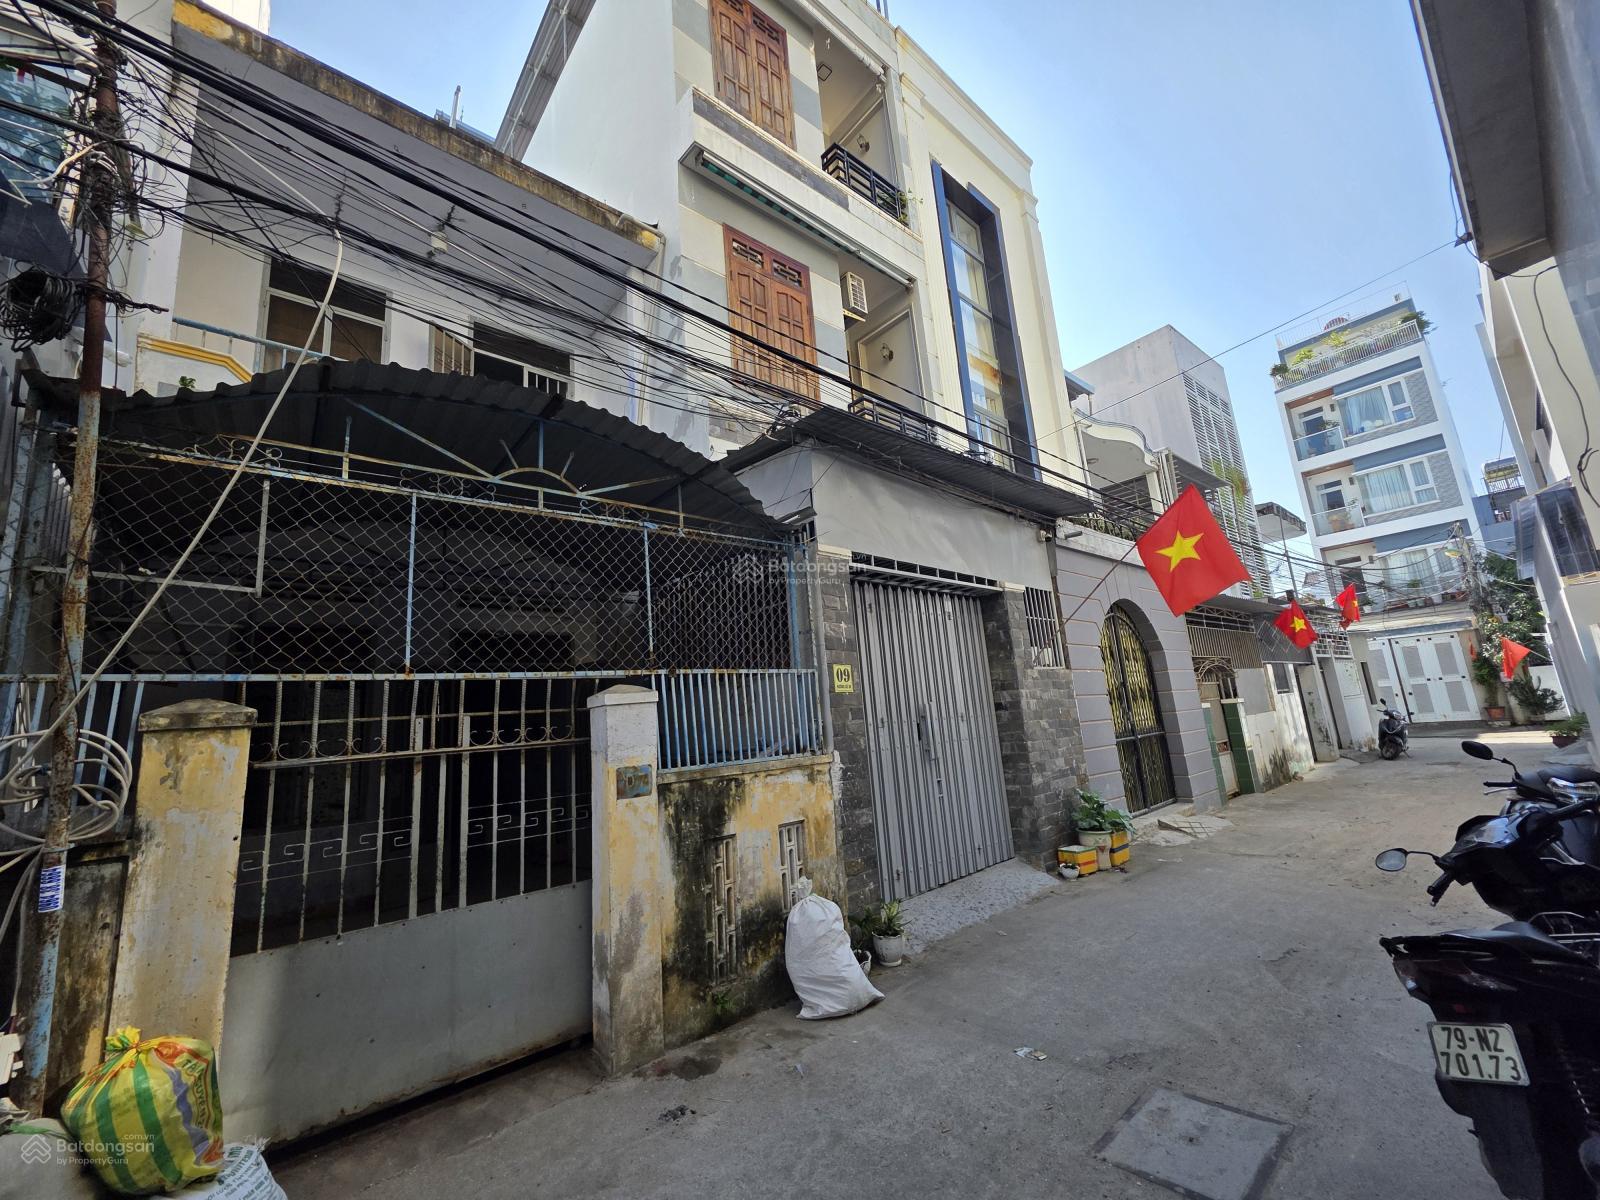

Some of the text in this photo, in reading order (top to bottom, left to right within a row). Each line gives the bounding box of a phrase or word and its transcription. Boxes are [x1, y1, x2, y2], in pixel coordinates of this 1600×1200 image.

[836, 667, 851, 683] 09
[1441, 1027, 1504, 1052] 79-N2
[1440, 1052, 1521, 1081] 701.73
